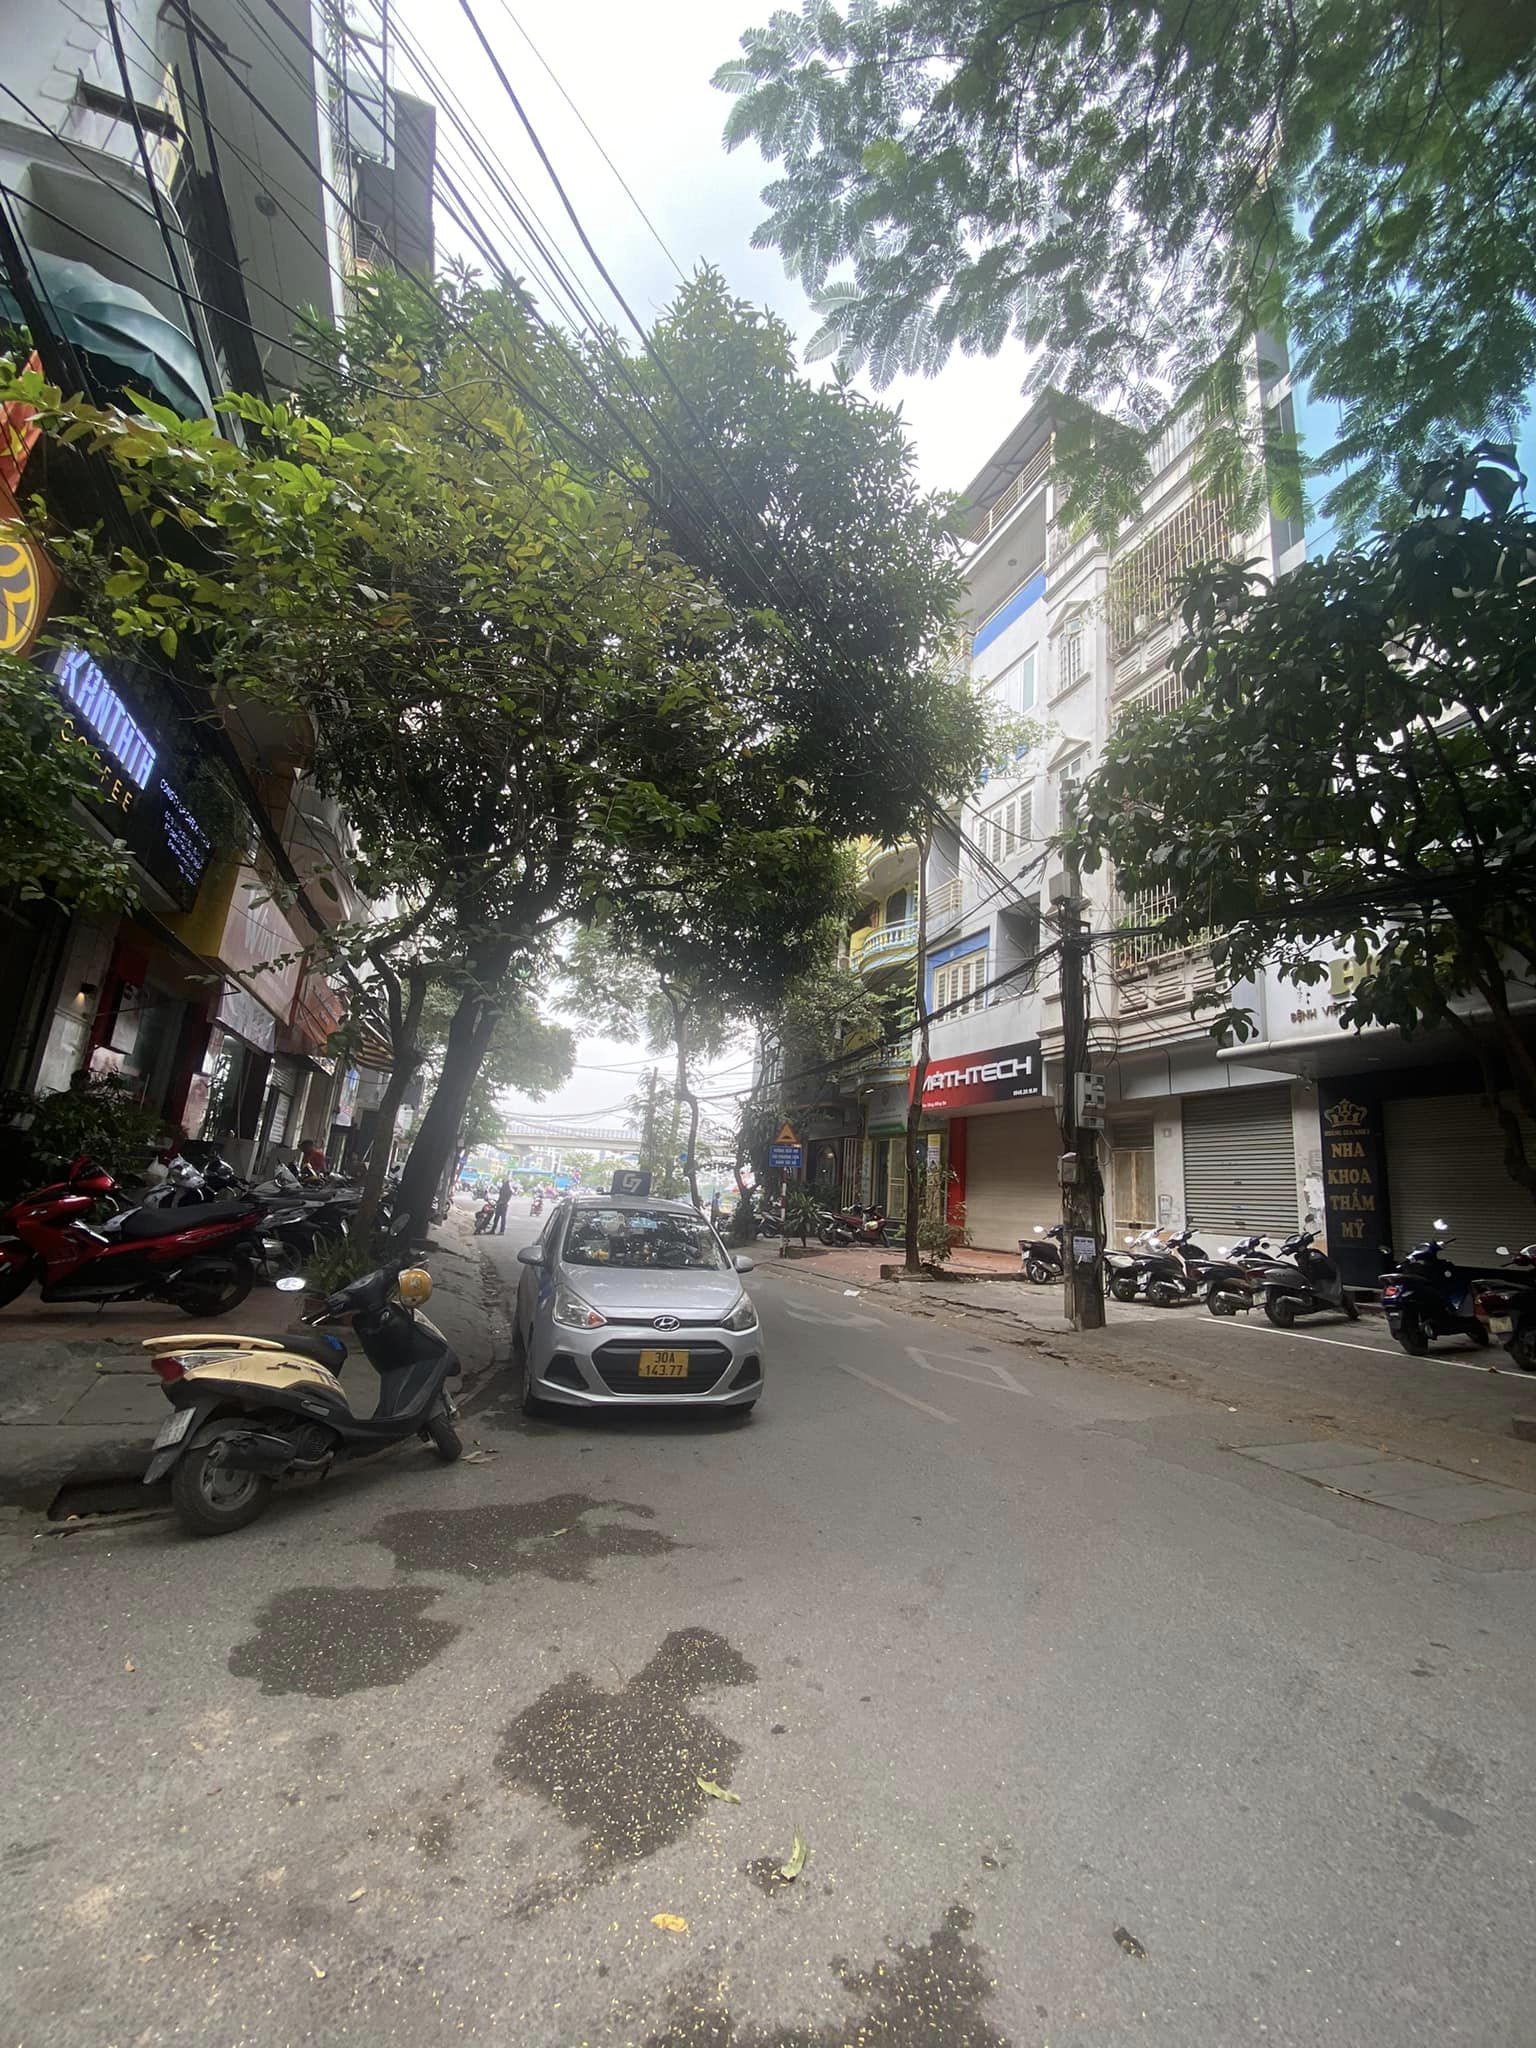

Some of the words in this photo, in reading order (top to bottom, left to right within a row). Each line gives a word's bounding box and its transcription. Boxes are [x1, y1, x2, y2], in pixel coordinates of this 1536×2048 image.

[1331, 1142, 1365, 1158] NHA
[622, 1173, 642, 1192] G7
[1327, 1167, 1371, 1185] KHOA
[1330, 1188, 1376, 1211] THẨM
[1341, 1217, 1365, 1239] MỸ
[655, 1352, 675, 1364] 30A
[646, 1364, 683, 1376] 143.77
